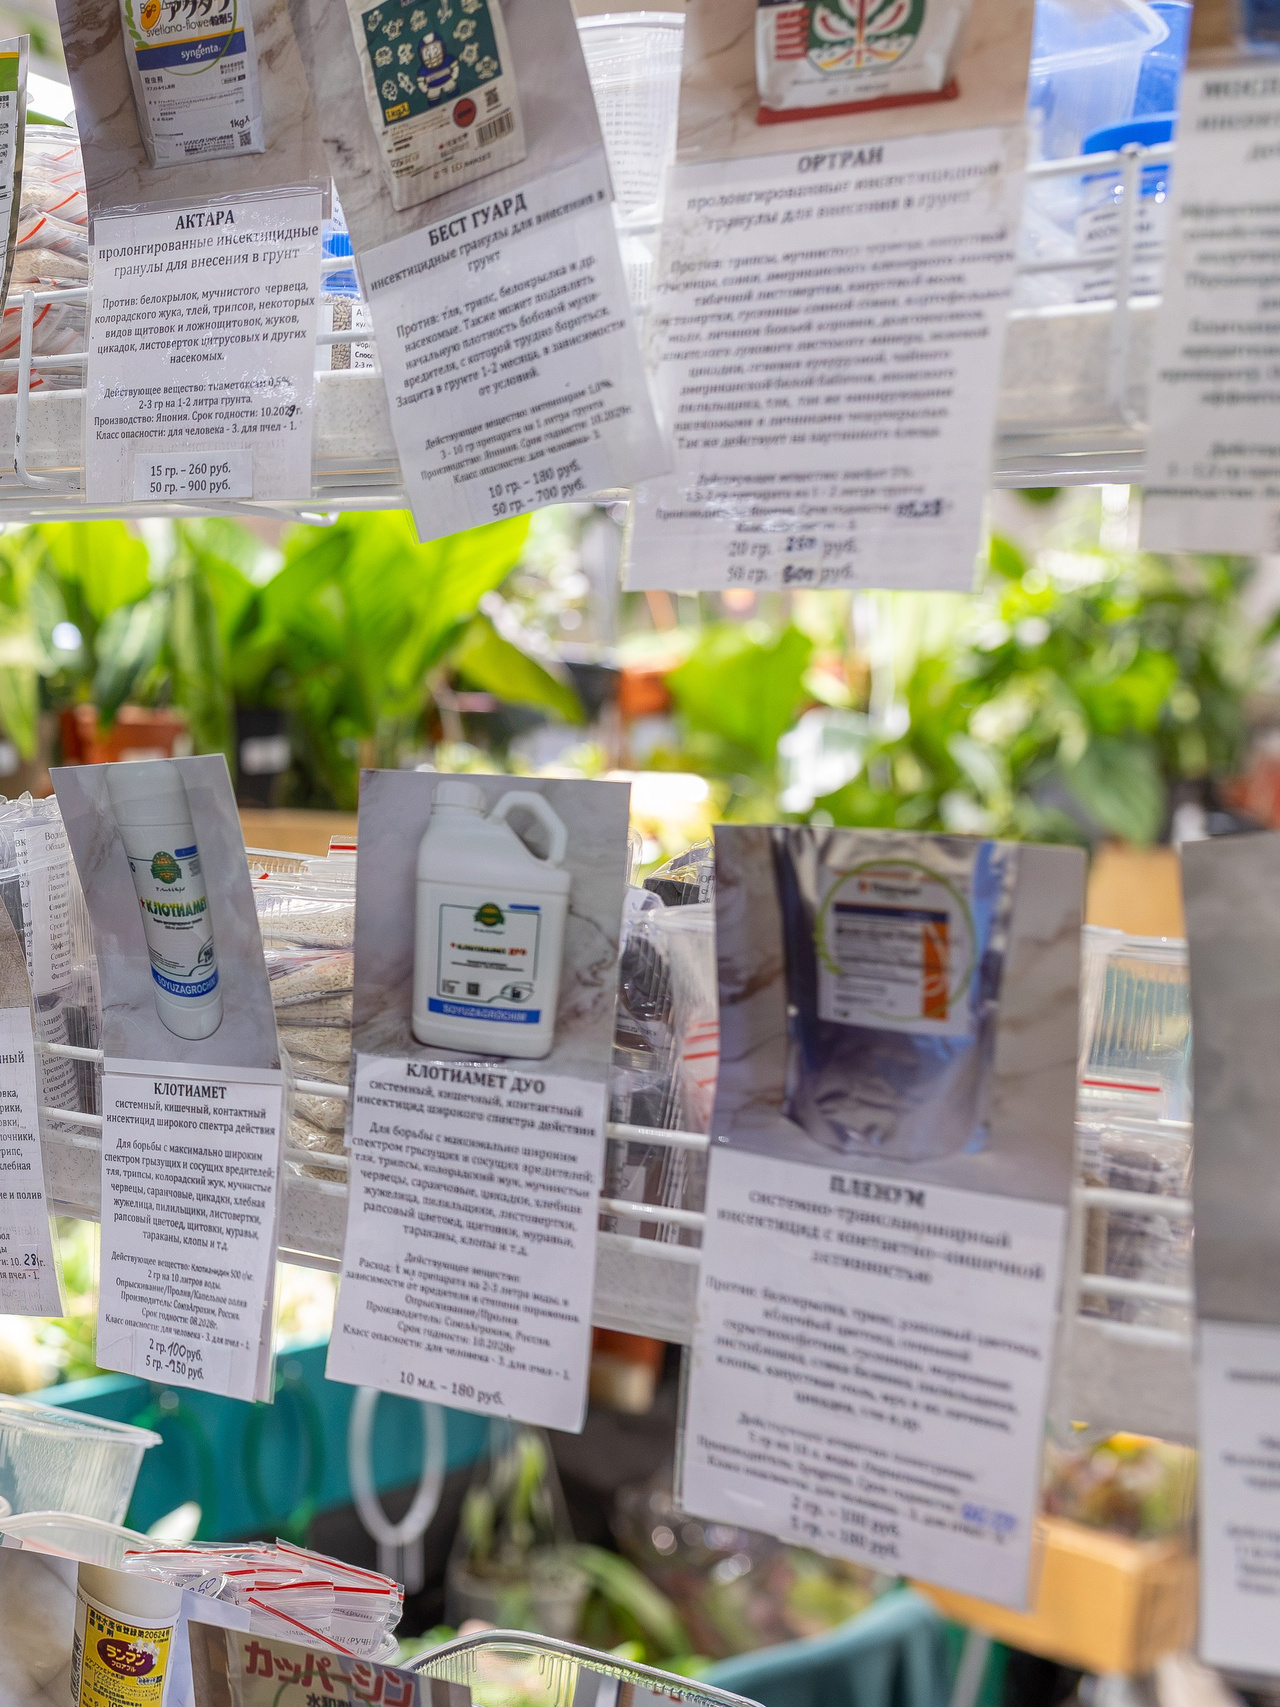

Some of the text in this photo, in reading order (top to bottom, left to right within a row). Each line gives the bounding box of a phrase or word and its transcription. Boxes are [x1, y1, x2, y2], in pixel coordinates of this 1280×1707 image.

[181, 43, 220, 61] syngenta
[174, 208, 235, 230] АКТАРА
[428, 192, 529, 247] БЕСТ ГУАРД
[98, 236, 213, 262] пролонгированные
[113, 248, 300, 279] гранулы для внесения в грунт
[102, 281, 308, 310] Против: белокрылок, мучнистого червеца,
[97, 342, 137, 355] цикадок,
[138, 337, 199, 352] листоверток
[262, 332, 269, 341] и
[270, 329, 306, 343] других
[169, 351, 224, 364] насекомых.
[150, 464, 162, 476] 15
[164, 467, 178, 477] гр.
[188, 462, 207, 475] 260
[209, 461, 231, 476] руб.
[149, 481, 162, 493] 50
[164, 483, 178, 494] гр.
[187, 479, 207, 491] 900
[208, 478, 231, 493] руб.
[153, 1082, 227, 1099] КЛОТИАМЕТ
[406, 1062, 545, 1096] КЛОТИАМЕТ ДУО
[114, 1097, 267, 1119] системный, кишечный, контактный
[148, 1337, 154, 1350] 2
[155, 1342, 167, 1356] гр.
[186, 1348, 203, 1362] руб.
[145, 1354, 151, 1367] 5
[151, 1358, 163, 1372] гр.
[187, 1364, 204, 1382] руб.
[106, 1644, 145, 1667] ランマン
